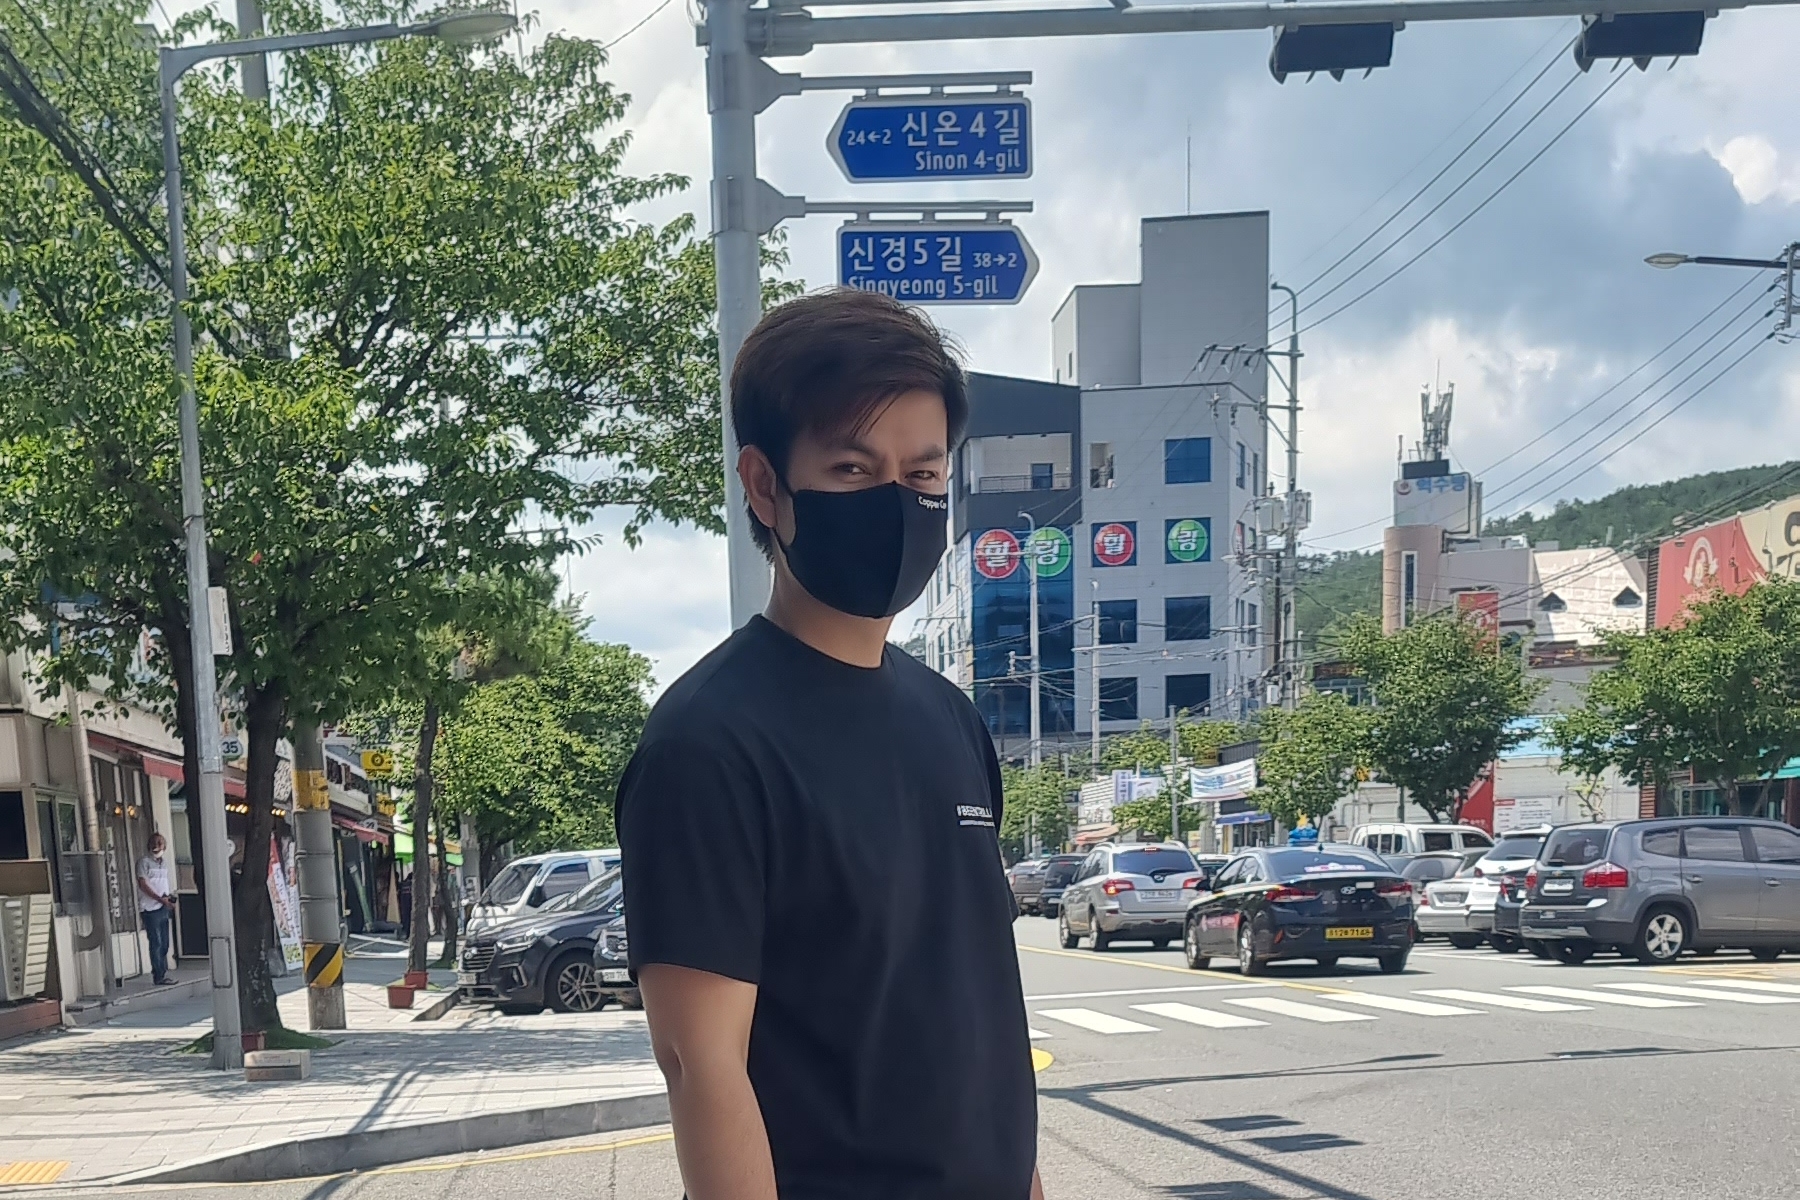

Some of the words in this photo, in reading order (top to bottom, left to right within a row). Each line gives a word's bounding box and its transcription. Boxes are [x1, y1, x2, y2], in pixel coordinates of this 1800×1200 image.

[902, 109, 1020, 147] 신온4길
[915, 150, 968, 171] Sinon
[973, 149, 1020, 172] 4-gil
[848, 236, 963, 273] 신경5길
[952, 275, 999, 299] 5-gil
[221, 741, 239, 754] 35
